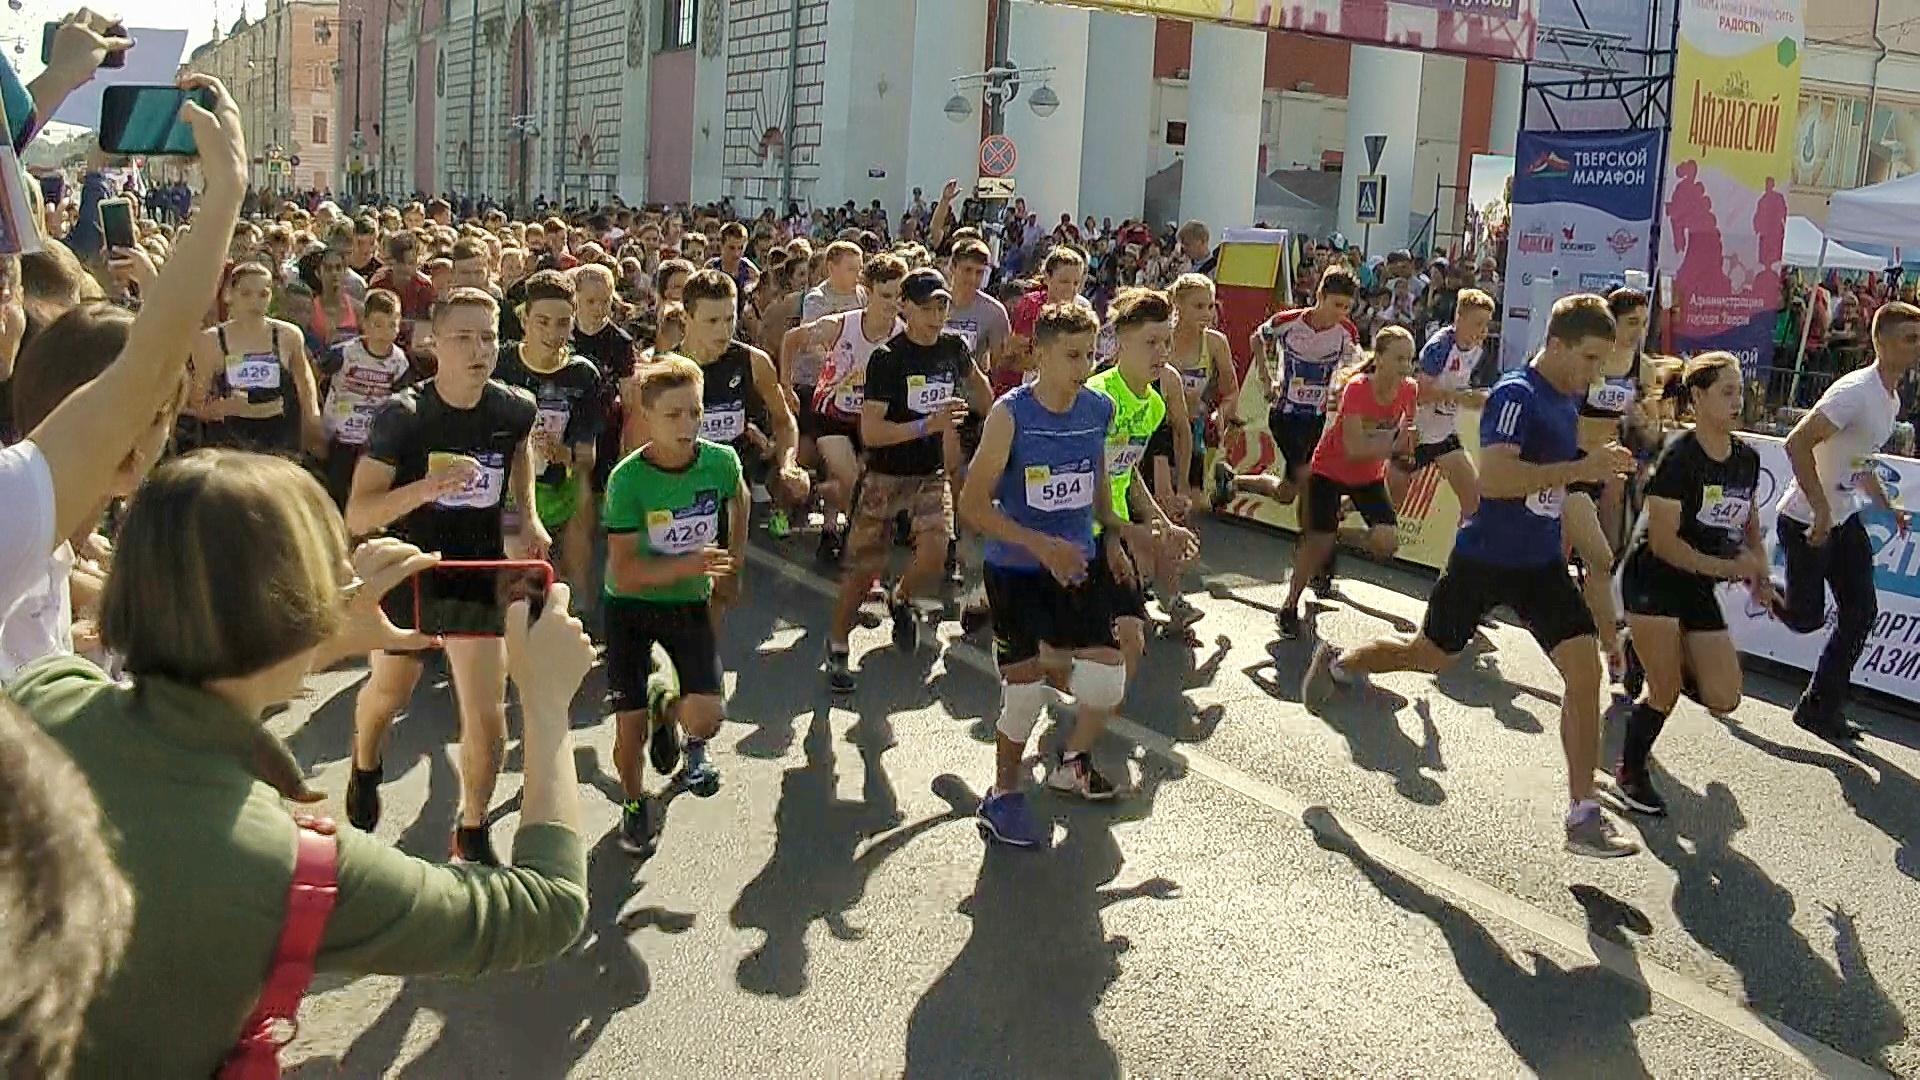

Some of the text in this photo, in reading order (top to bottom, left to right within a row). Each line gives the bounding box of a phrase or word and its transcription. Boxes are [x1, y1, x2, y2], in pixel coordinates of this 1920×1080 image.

[1688, 79, 1780, 158] Афанасий
[1574, 148, 1647, 167] ТВЕРСКОЙ
[1572, 170, 1646, 185] МАРАФОН
[1042, 478, 1081, 501] 584
[1710, 503, 1742, 518] 547
[664, 521, 708, 543] 420
